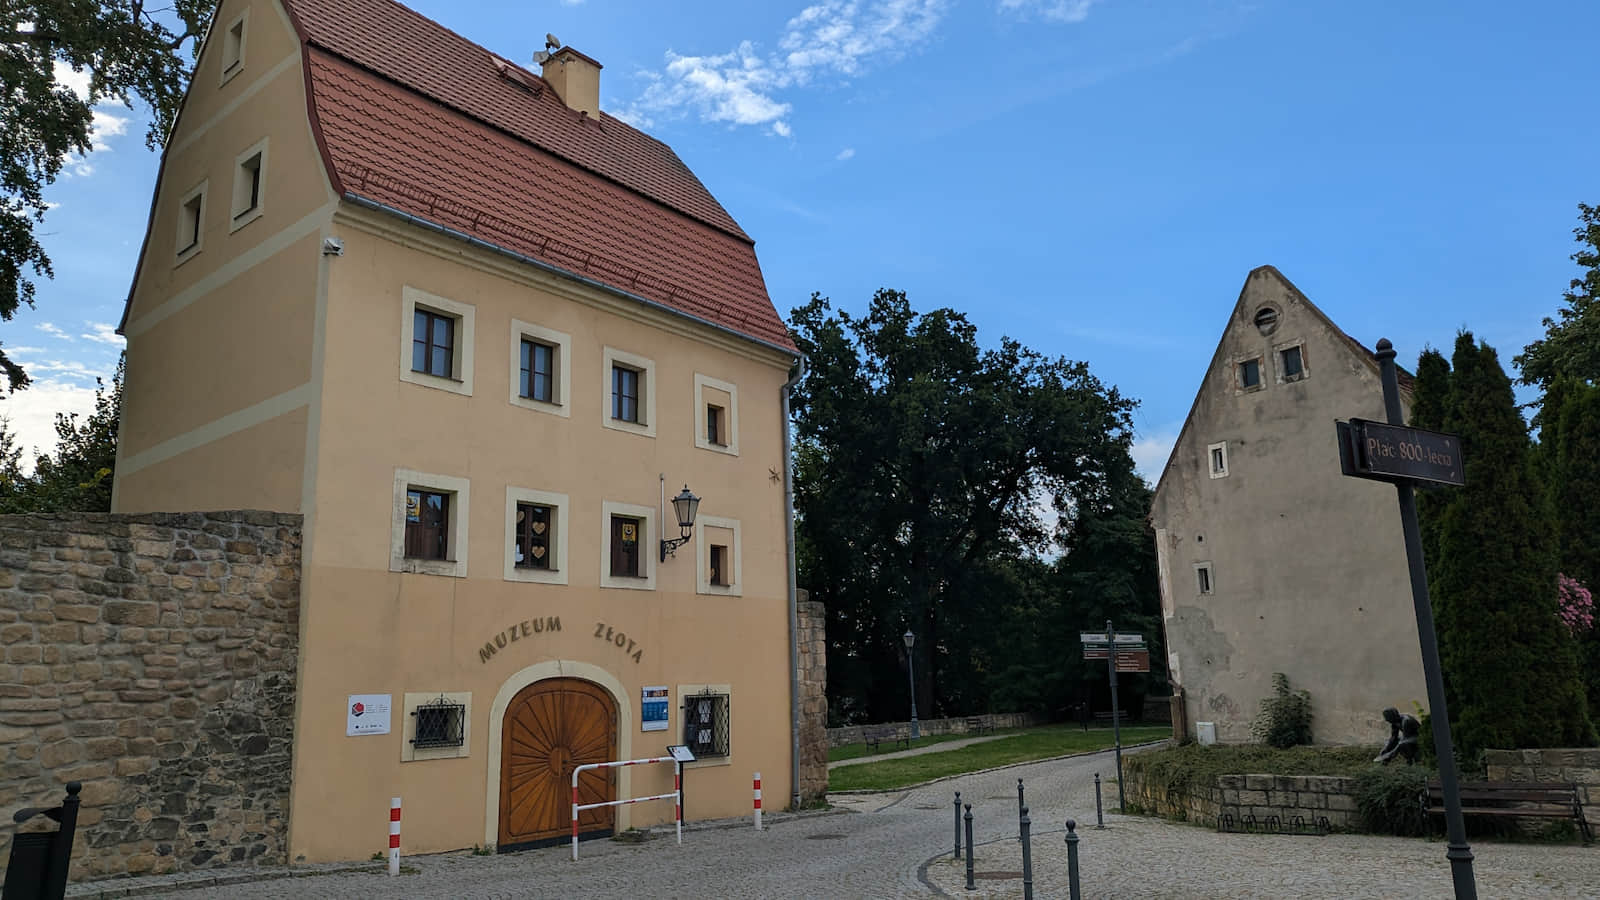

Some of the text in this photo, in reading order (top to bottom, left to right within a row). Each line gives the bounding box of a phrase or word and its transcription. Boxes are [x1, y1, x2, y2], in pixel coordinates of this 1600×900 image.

[1367, 438, 1452, 466] Plac 800-lecia
[479, 615, 643, 664] MUZEUM ZŁOTA
